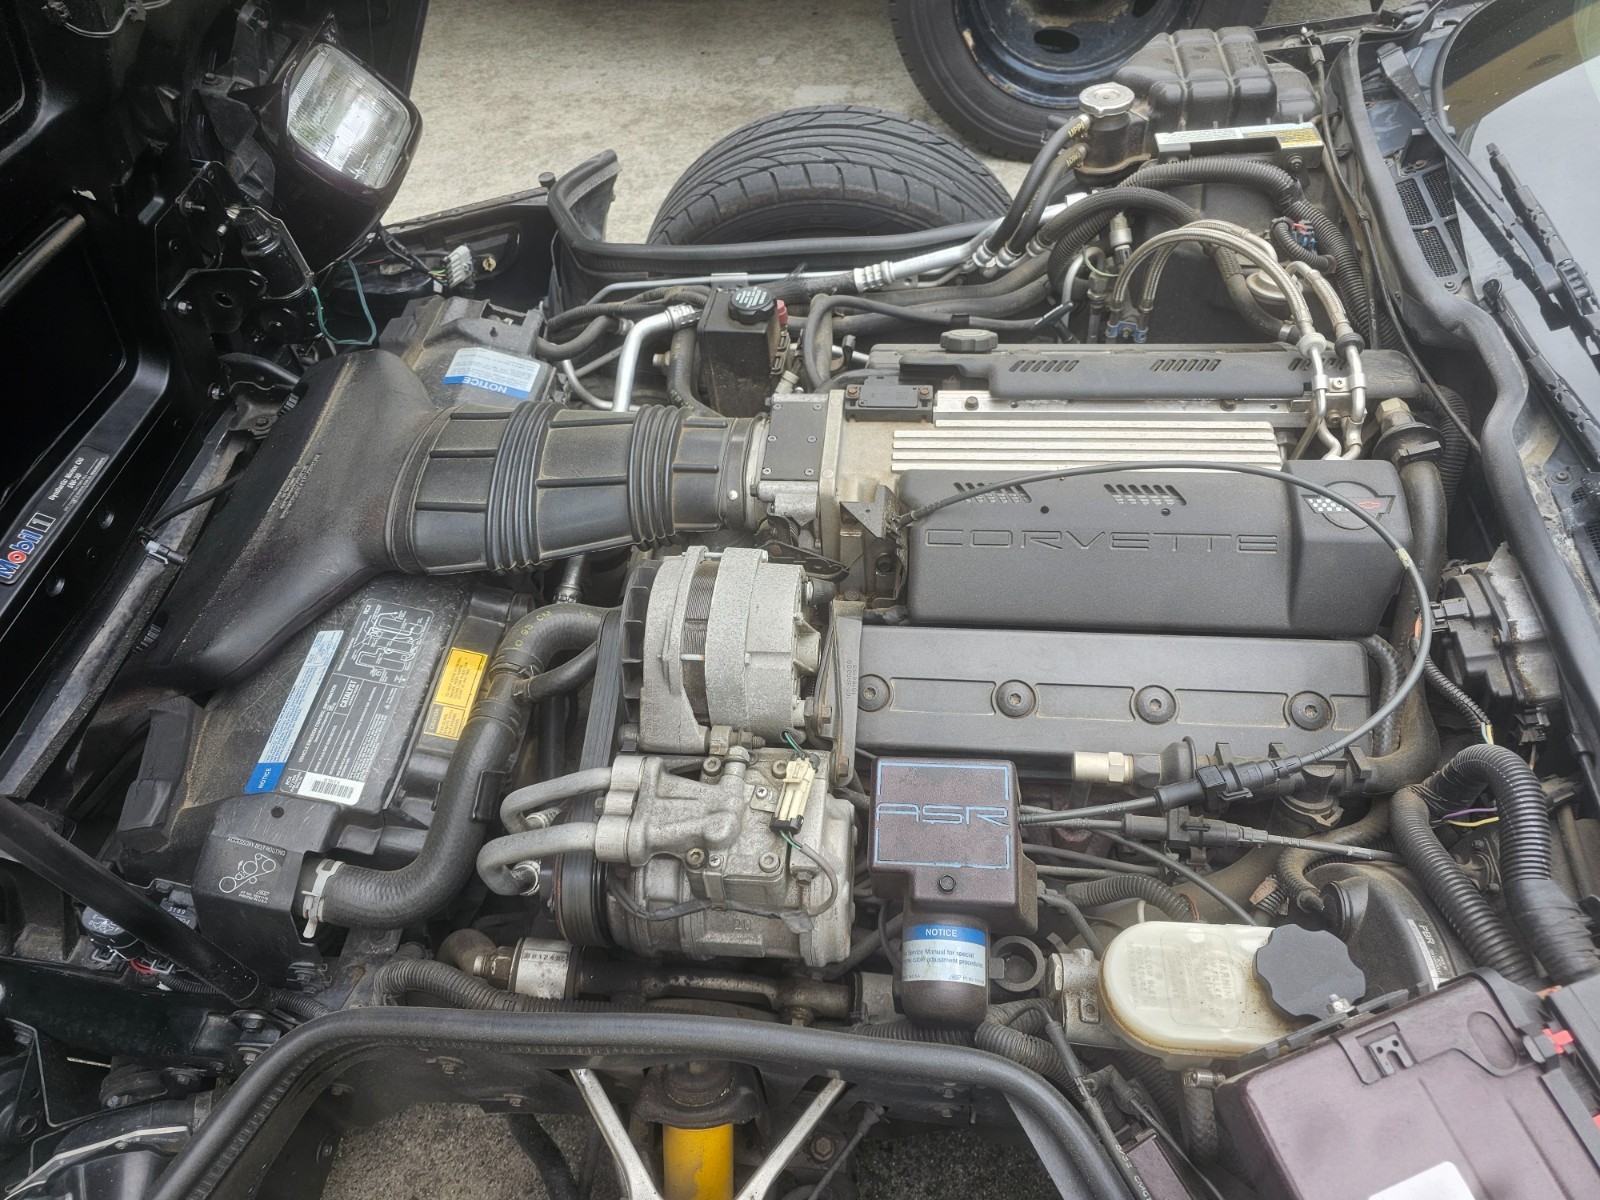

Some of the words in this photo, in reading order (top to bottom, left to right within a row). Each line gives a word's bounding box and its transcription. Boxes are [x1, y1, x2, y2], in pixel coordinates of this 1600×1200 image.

[463, 376, 508, 393] NOTICE
[925, 530, 1277, 553] CORVETTE
[0, 529, 43, 579] Mobil
[340, 680, 357, 708] CATALYST
[258, 768, 271, 789] NOTICE
[876, 803, 1009, 827] ASR
[227, 836, 254, 847] ACCESSORY
[925, 928, 957, 937] NOTICE
[1419, 925, 1435, 944] PBR
